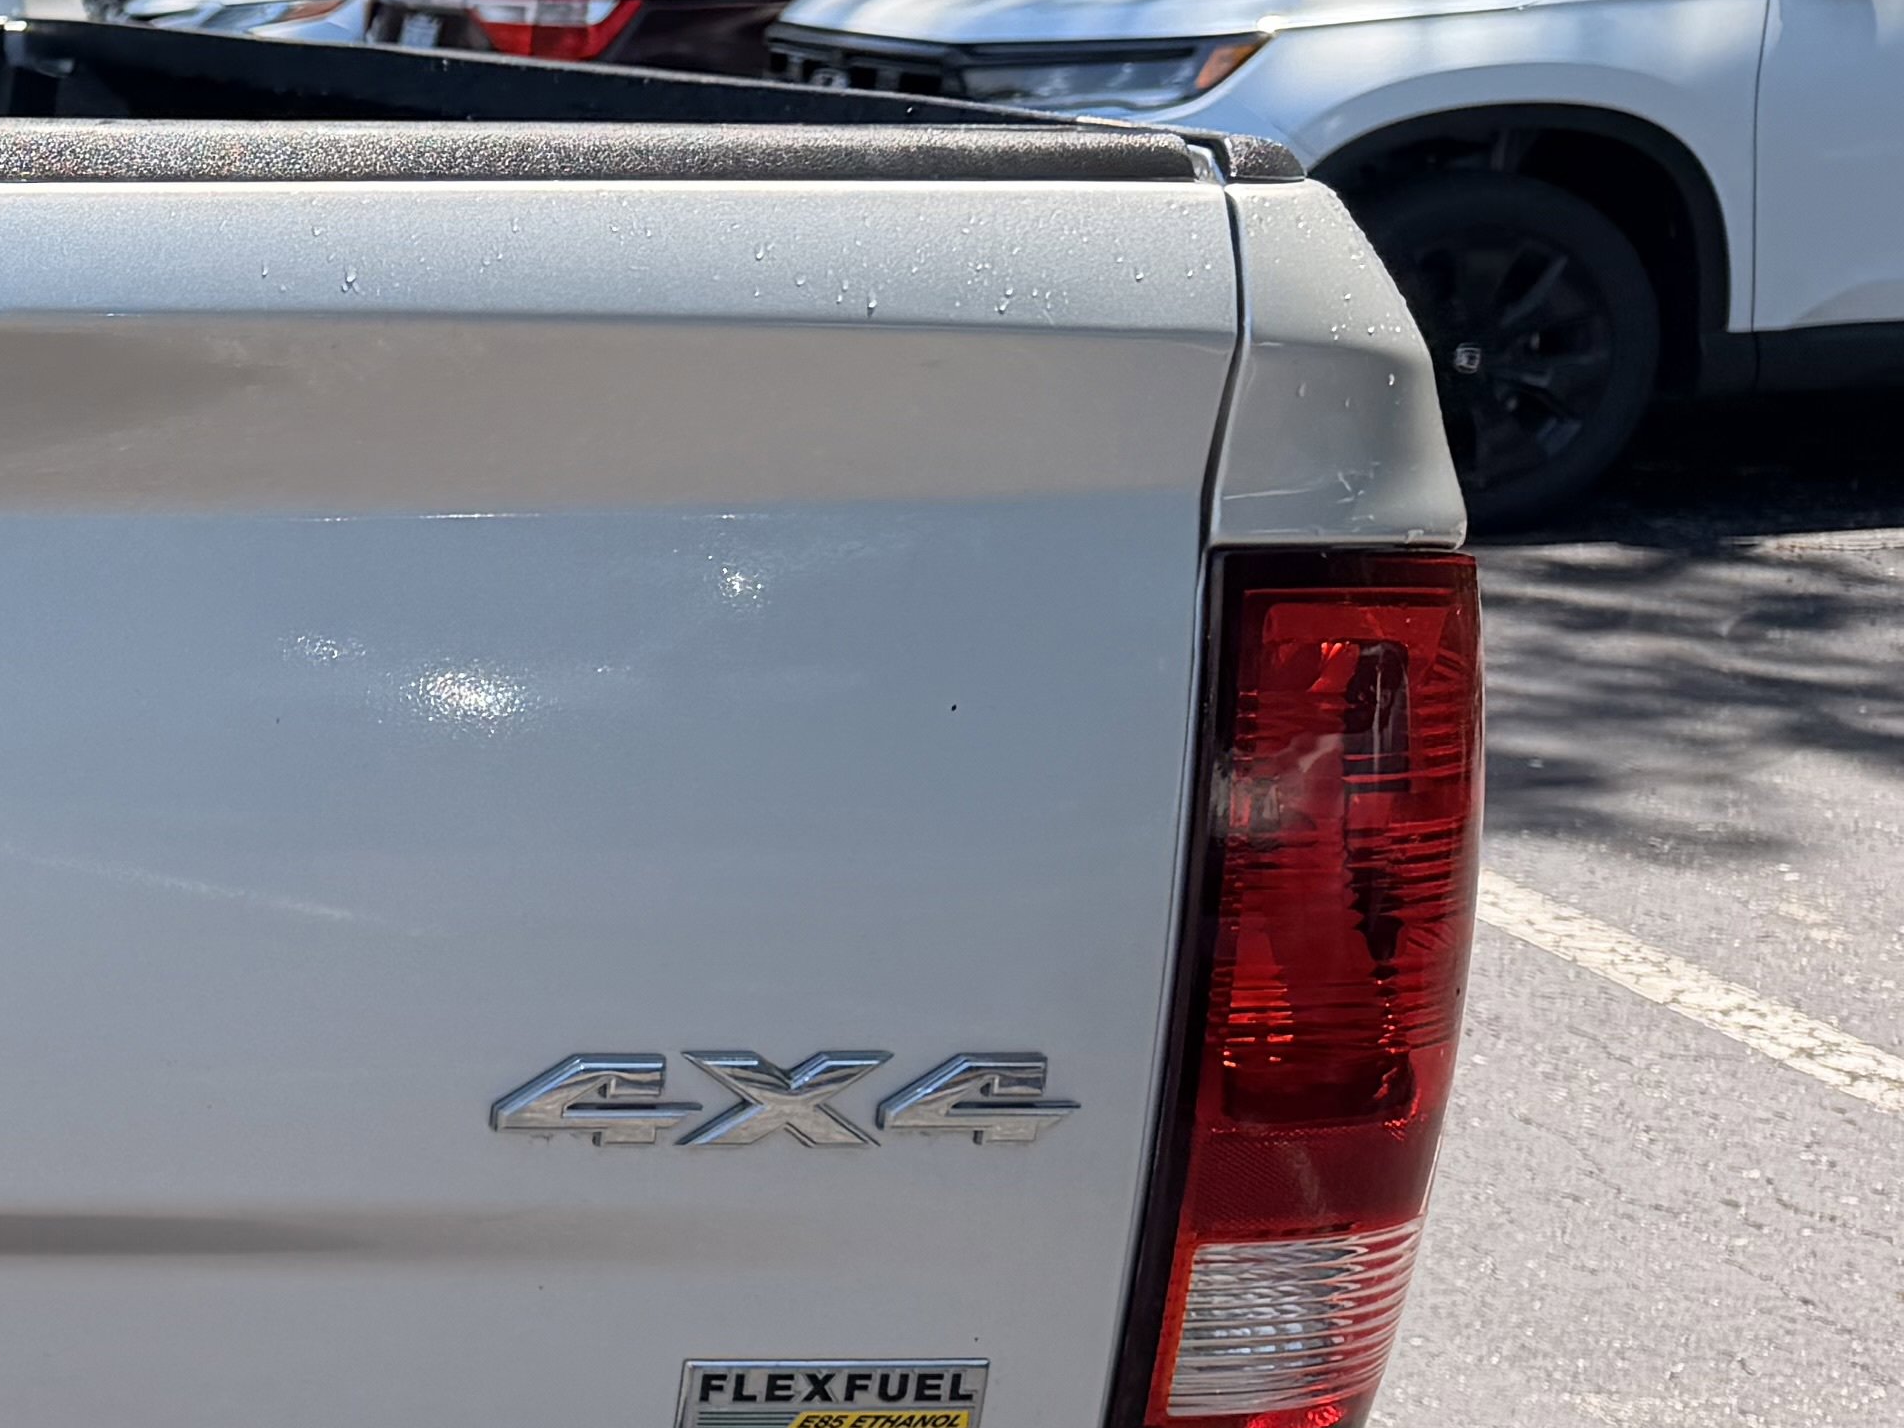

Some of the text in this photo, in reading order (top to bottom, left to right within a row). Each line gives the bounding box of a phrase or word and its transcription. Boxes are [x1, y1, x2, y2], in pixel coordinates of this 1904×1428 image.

[698, 1372, 975, 1403] FLEXFUEL
[796, 1413, 962, 1428] E85 ETHANOL
